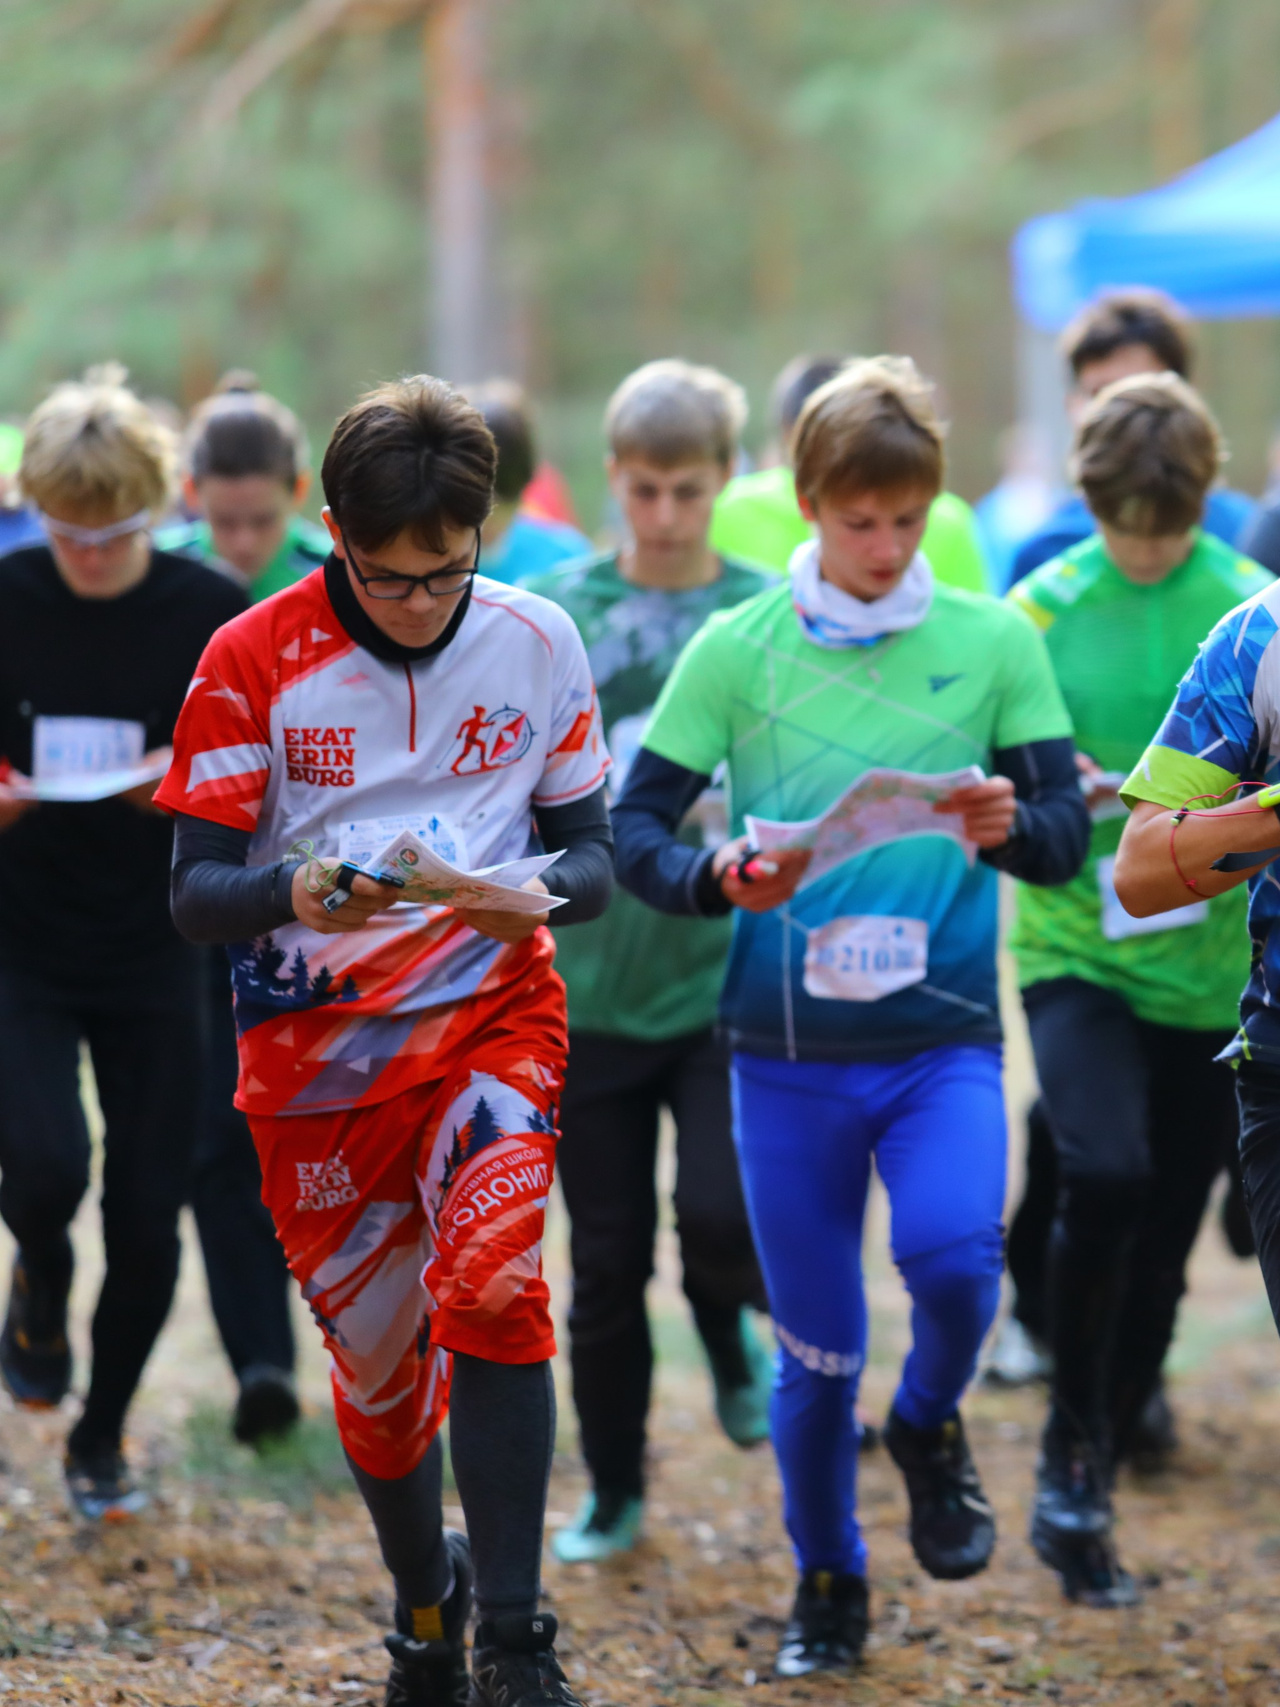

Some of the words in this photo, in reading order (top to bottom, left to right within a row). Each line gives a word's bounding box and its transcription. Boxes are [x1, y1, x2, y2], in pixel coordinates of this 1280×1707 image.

[283, 727, 356, 746] EKAT
[286, 747, 355, 767] ERIN
[287, 766, 355, 787] BURG
[443, 1163, 549, 1246] РОДОНИТ
